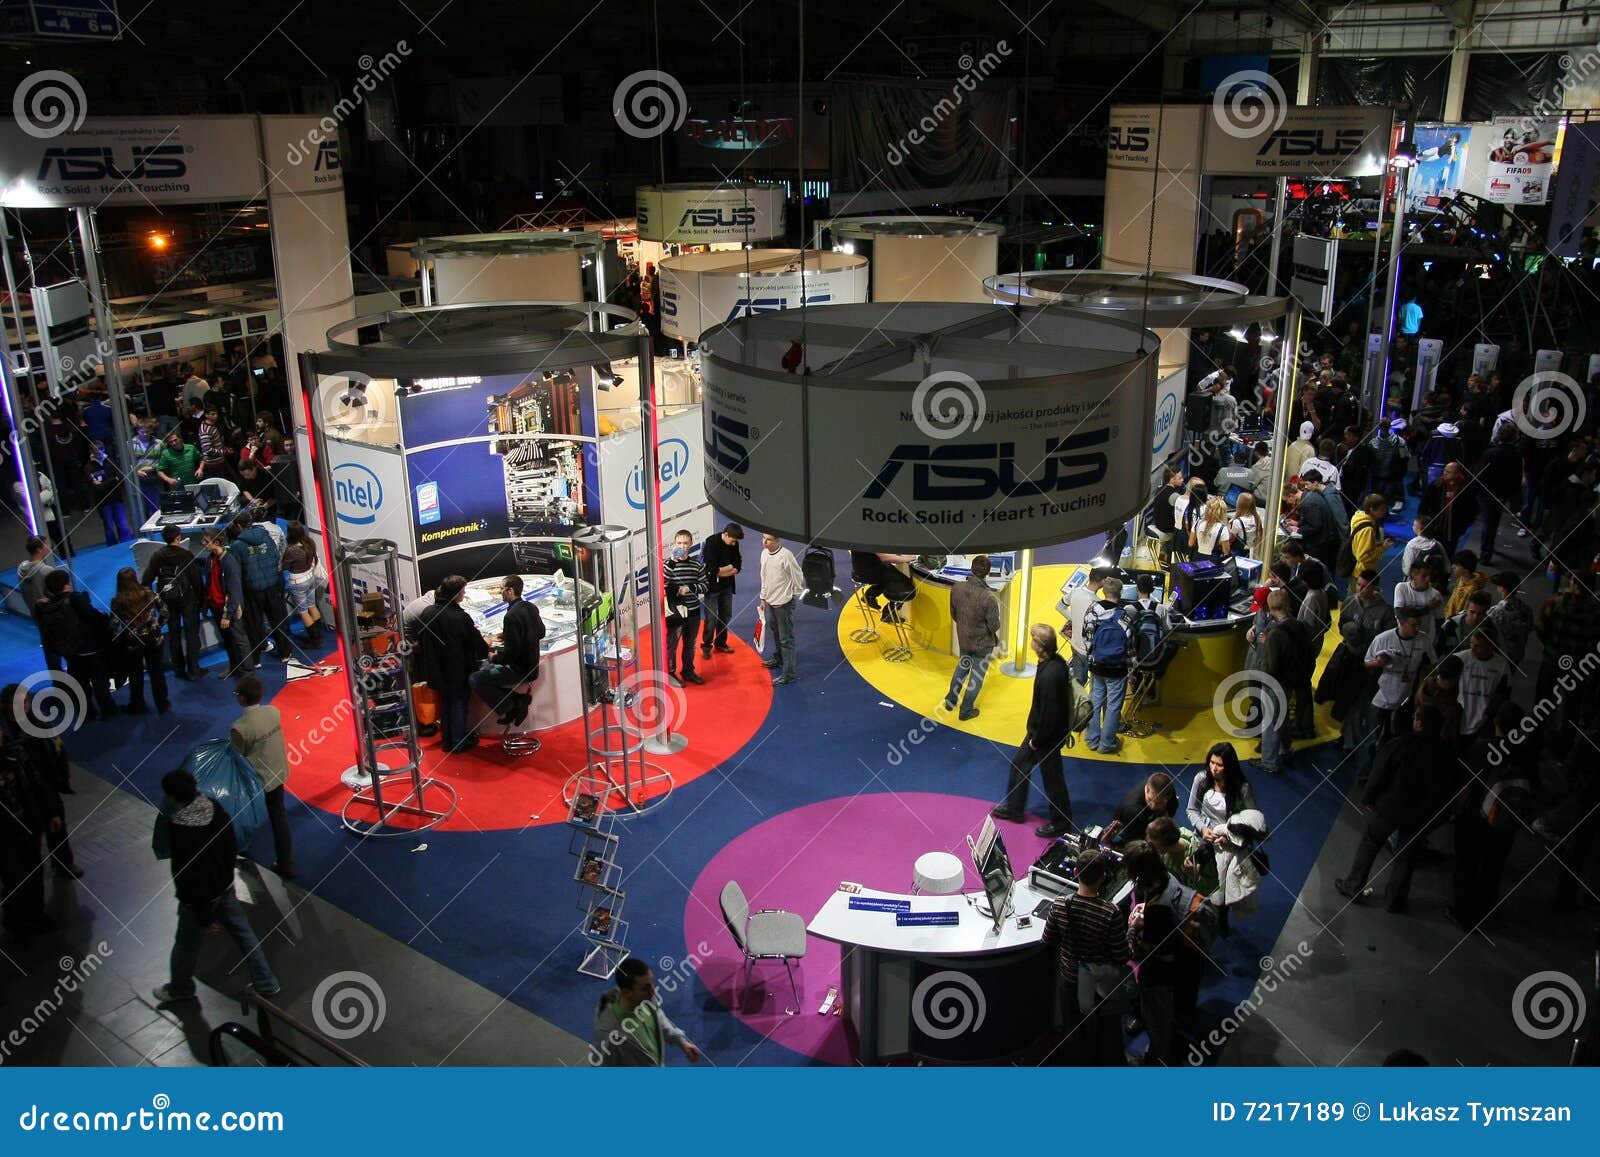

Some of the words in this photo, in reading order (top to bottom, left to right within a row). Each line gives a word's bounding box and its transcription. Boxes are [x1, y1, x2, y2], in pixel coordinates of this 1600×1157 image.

[60, 17, 71, 31] 4
[88, 19, 99, 32] 6
[1109, 126, 1150, 152] SUS
[1257, 129, 1364, 155] ASUS
[37, 146, 187, 180] ASUS
[1256, 159, 1277, 167] Rock
[1279, 159, 1301, 167] Solid
[1307, 159, 1330, 167] Heart
[64, 185, 91, 194] Solid
[101, 184, 134, 194] Heart
[137, 182, 190, 193] Touching
[678, 207, 756, 227] ASUS
[995, 408, 1034, 422] jakości
[1036, 403, 1081, 419] produkty
[862, 427, 1110, 501] ASUS
[335, 478, 374, 510] ntel
[713, 467, 751, 500] Touching
[862, 508, 909, 523] Rock
[915, 509, 964, 524] Solid
[983, 504, 1036, 522] Heart
[1040, 493, 1107, 517] Touching
[421, 522, 480, 543] Komputronik
